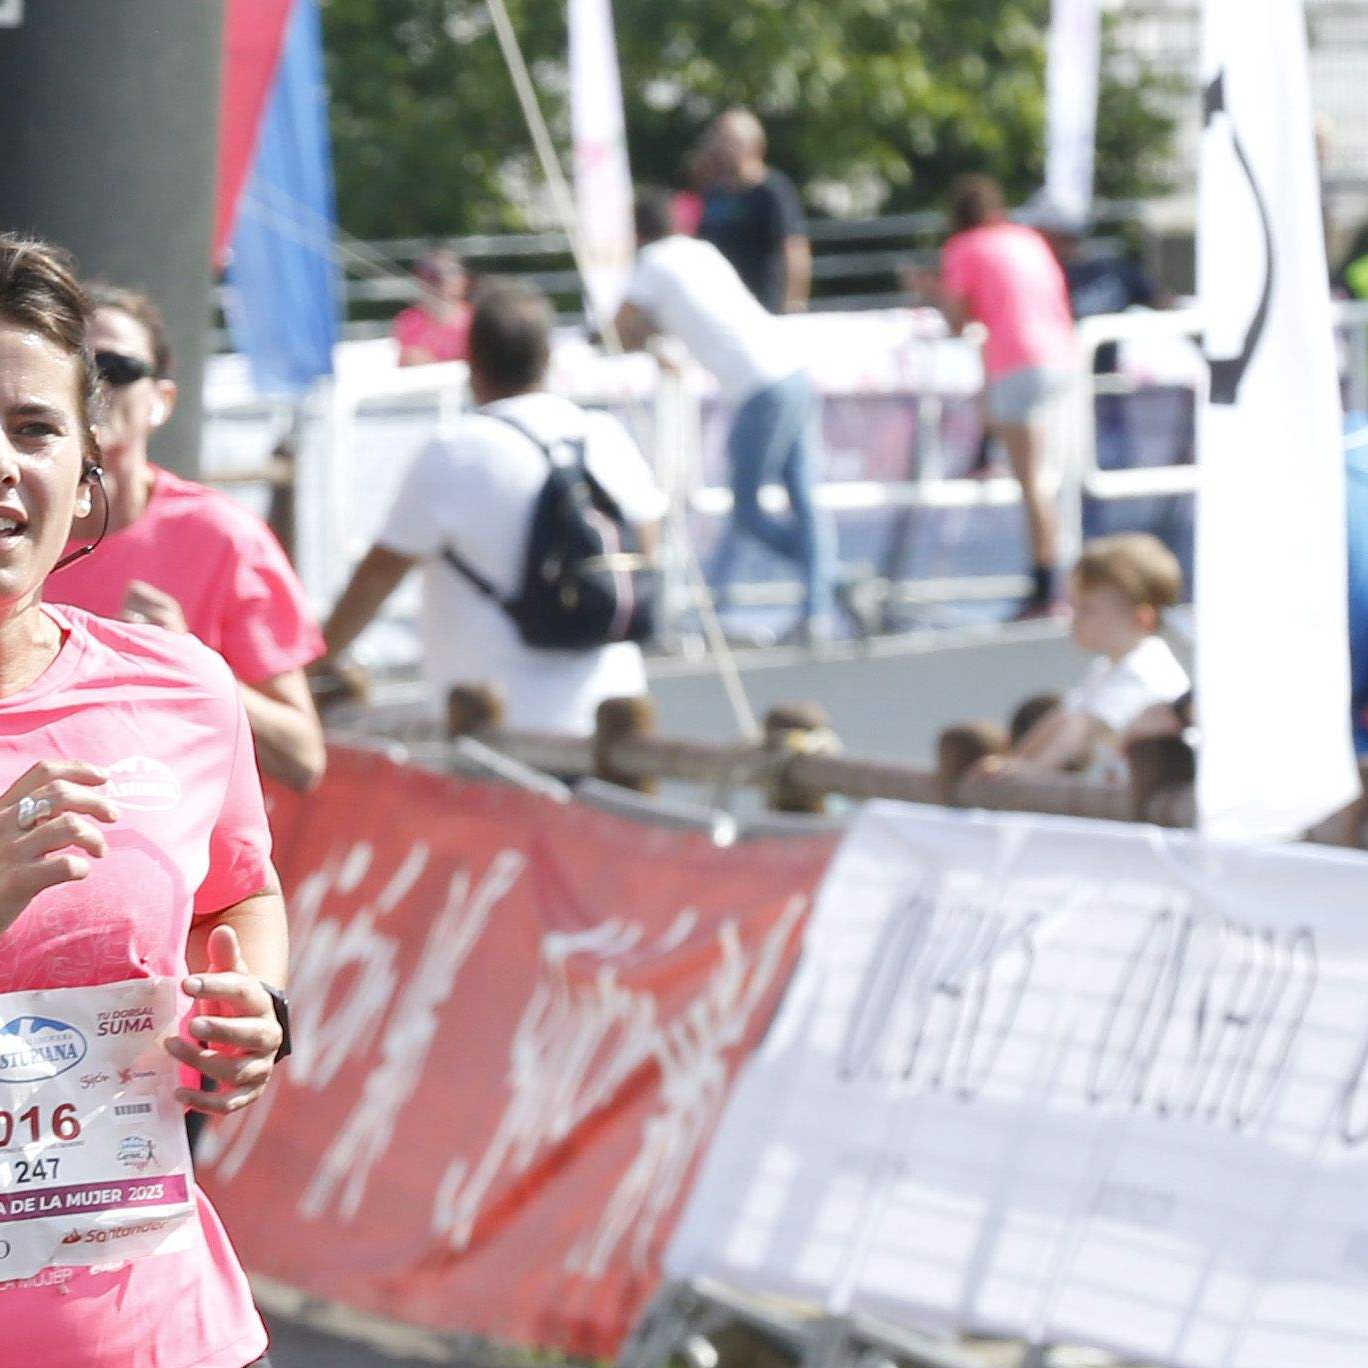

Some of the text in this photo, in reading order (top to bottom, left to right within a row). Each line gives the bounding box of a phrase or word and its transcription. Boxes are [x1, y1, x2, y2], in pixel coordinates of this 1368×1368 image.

[97, 1012, 111, 1020] TU
[97, 1017, 154, 1037] SUMA
[15, 1158, 61, 1184] 247
[9, 1198, 36, 1216] DE
[38, 1195, 63, 1211] LA
[65, 1188, 123, 1207] MUJER
[127, 1183, 165, 1202] 2023
[84, 1220, 169, 1243] Santander
